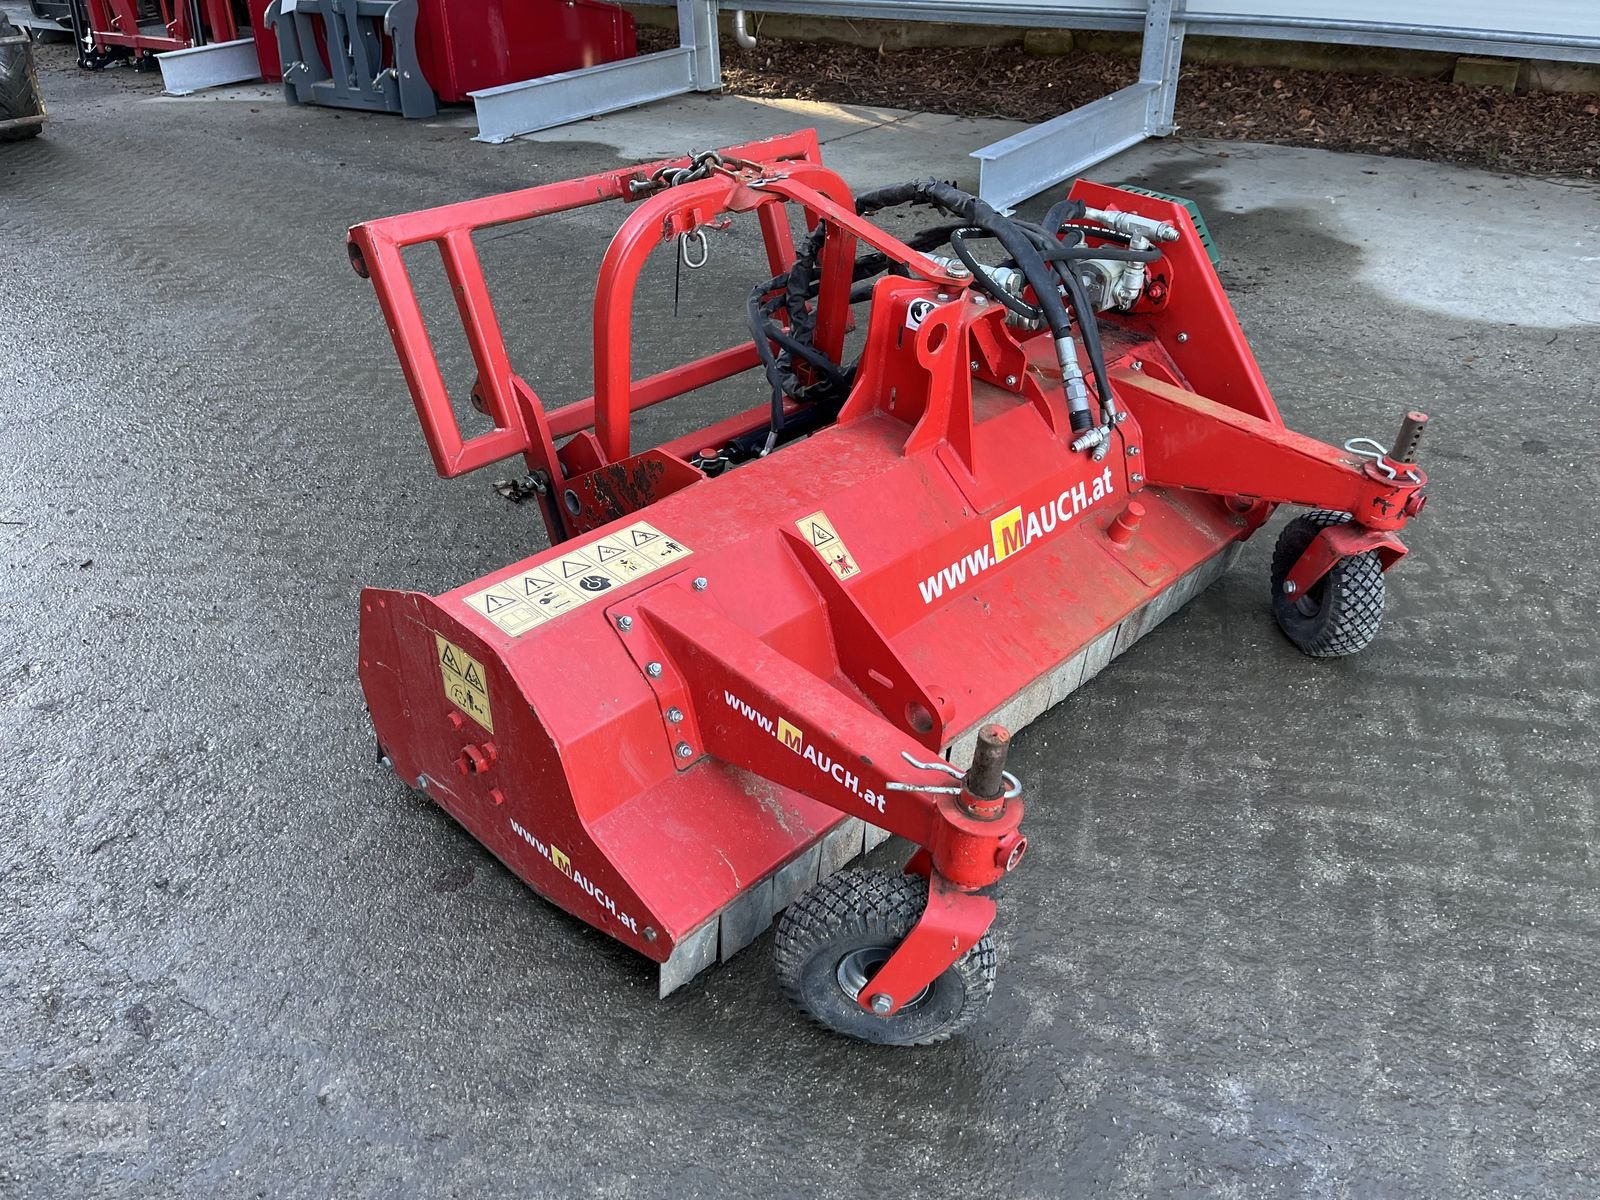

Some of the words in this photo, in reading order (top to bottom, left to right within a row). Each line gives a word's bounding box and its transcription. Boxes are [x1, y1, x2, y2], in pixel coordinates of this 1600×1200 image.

[918, 466, 1113, 604] www.MAUCH.at
[724, 690, 886, 813] www.MAUCH.at
[510, 817, 638, 935] www.MAUCH.at
